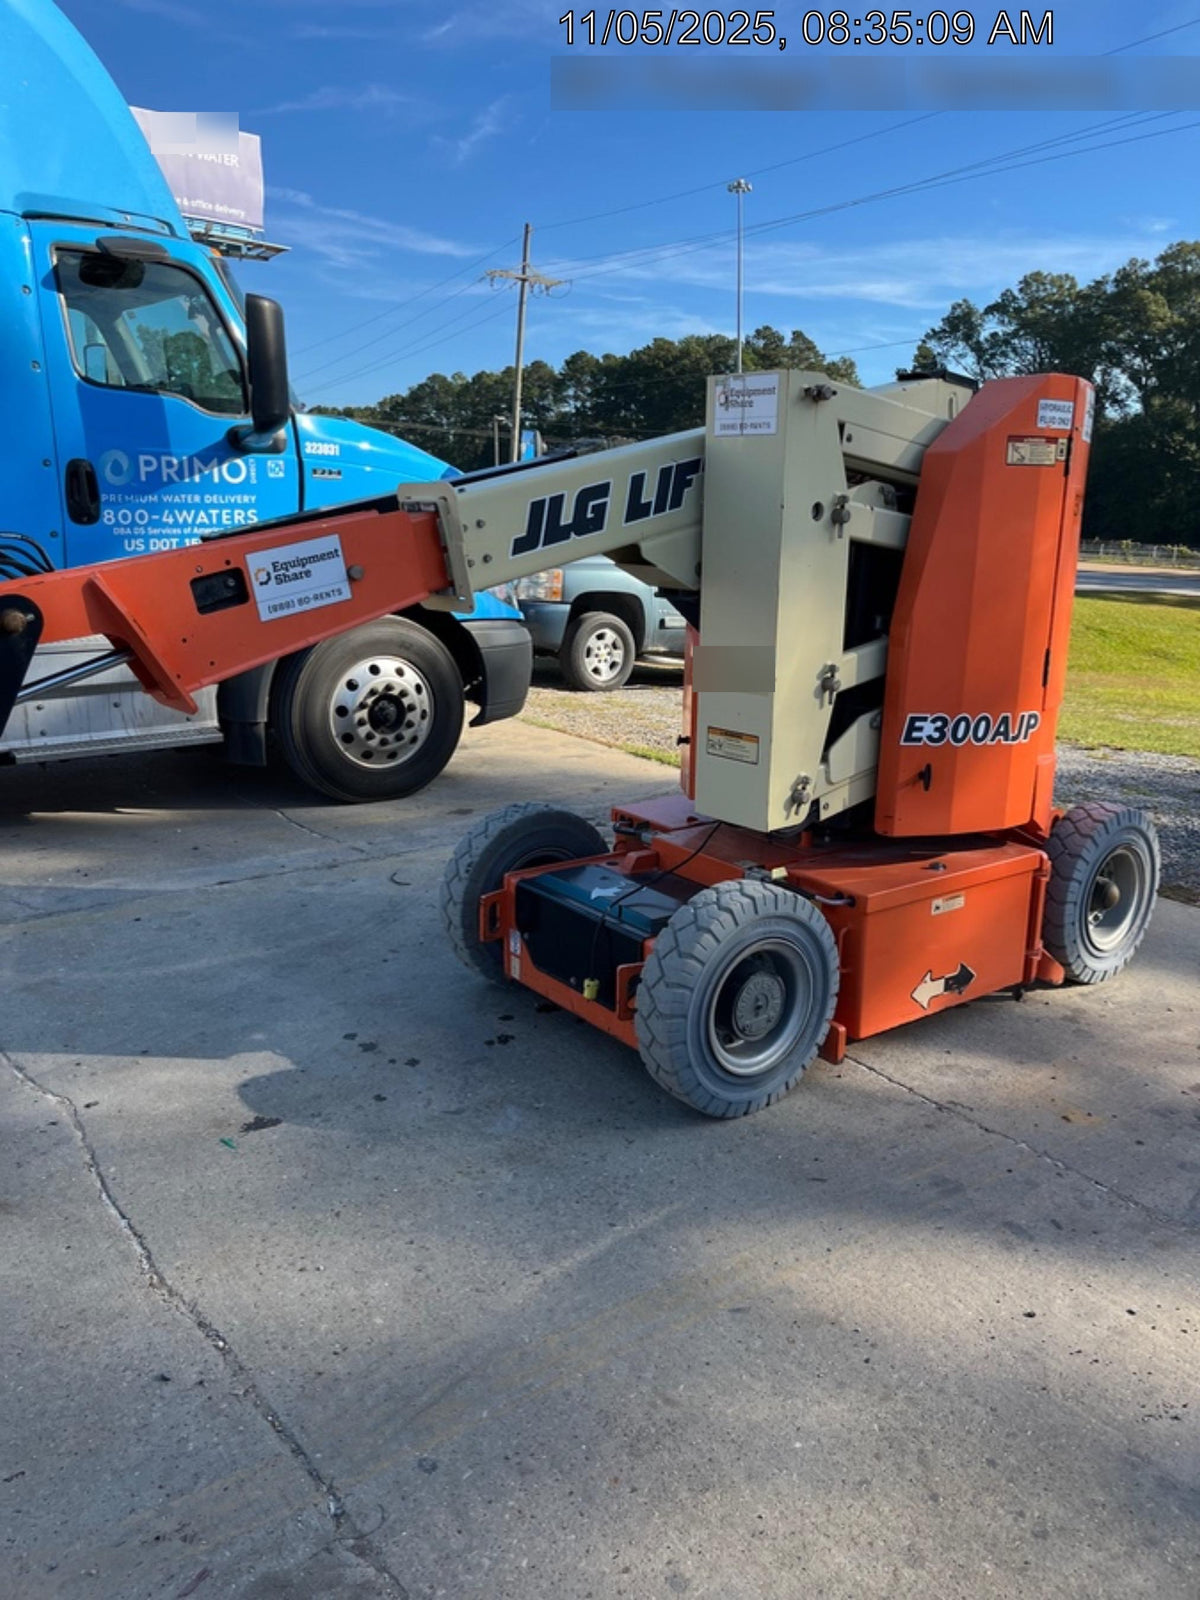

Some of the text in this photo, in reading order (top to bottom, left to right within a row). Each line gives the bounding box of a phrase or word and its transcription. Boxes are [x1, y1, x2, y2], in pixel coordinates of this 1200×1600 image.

[191, 199, 213, 210] office
[215, 202, 246, 219] delivery
[139, 454, 248, 484] PRIMO
[101, 494, 257, 504] PREMIUM WATER DELIVERY
[510, 457, 705, 559] JLG LIF
[103, 508, 259, 525] 800-4WATERS
[147, 526, 182, 535] Services
[183, 526, 192, 535] of
[124, 538, 145, 551] US
[149, 538, 179, 550] DOT
[271, 548, 340, 573] Equipment
[274, 569, 312, 585] Share
[900, 711, 1040, 746] E300AJP
